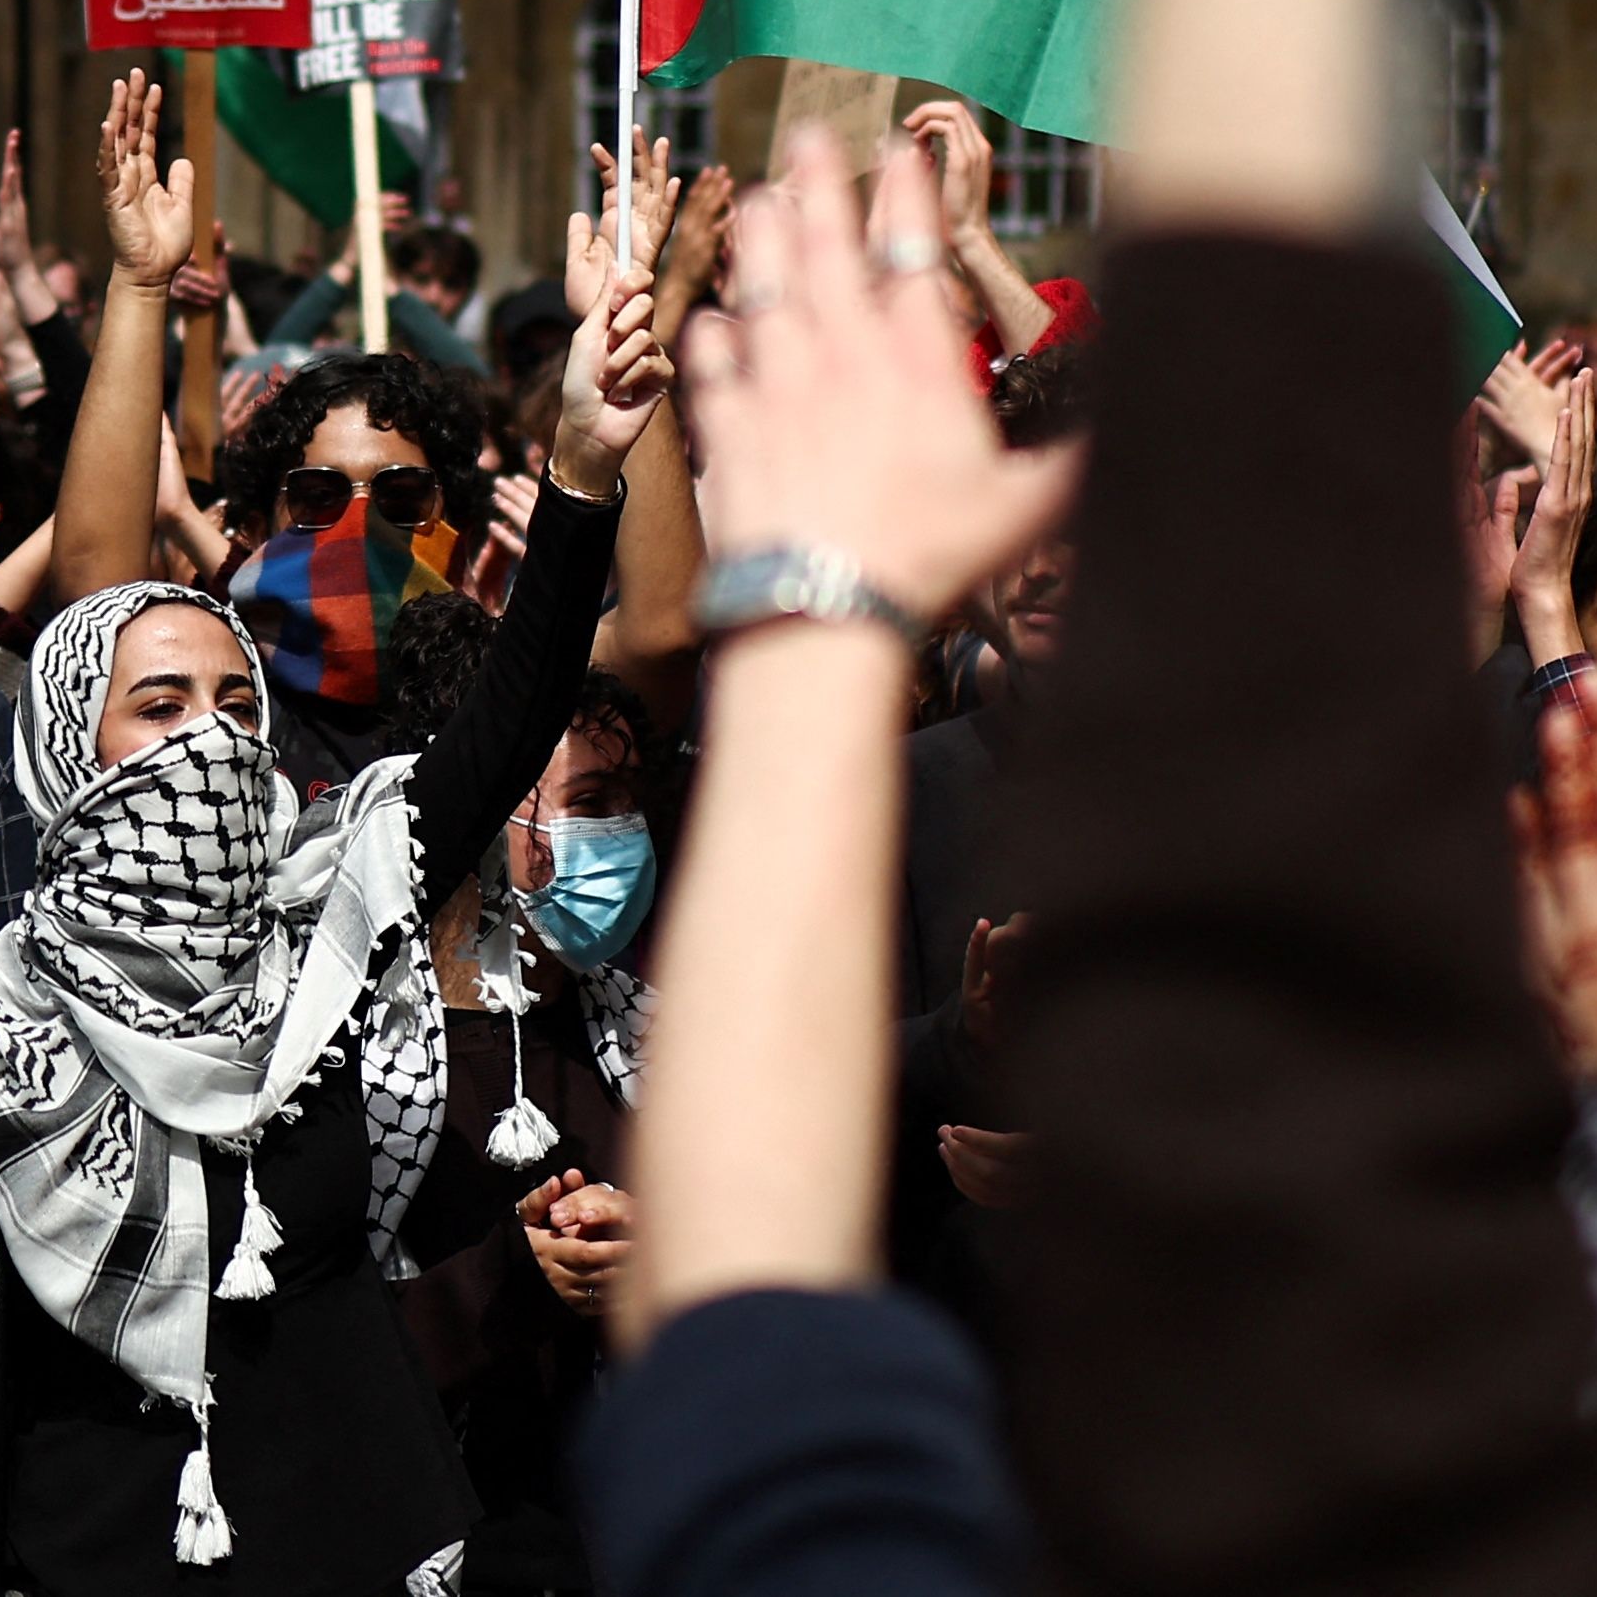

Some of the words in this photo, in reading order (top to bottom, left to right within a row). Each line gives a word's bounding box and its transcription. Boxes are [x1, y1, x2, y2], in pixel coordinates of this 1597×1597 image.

[313, 4, 359, 45] ILL
[363, 1, 403, 40] BE
[297, 41, 362, 89] FREE
